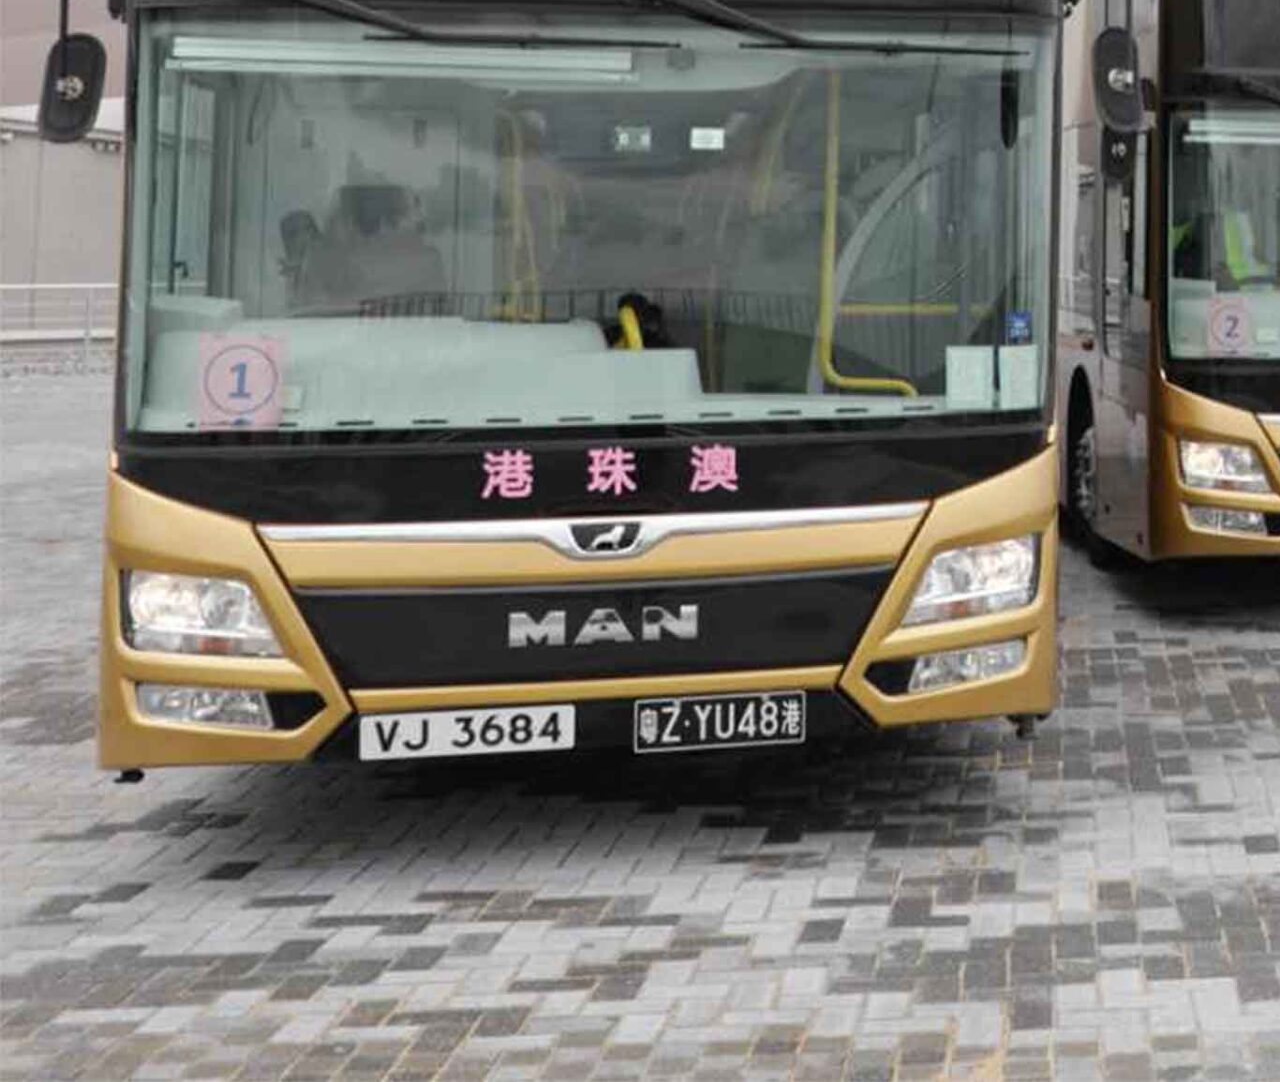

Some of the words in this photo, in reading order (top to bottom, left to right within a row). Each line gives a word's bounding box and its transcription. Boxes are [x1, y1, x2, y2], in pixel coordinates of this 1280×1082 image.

[1225, 315, 1240, 338] 2
[229, 362, 251, 398] 1
[481, 444, 739, 499] 港珠澳
[508, 604, 698, 648] MAN
[375, 719, 429, 752] VJ
[451, 712, 562, 748] 3684
